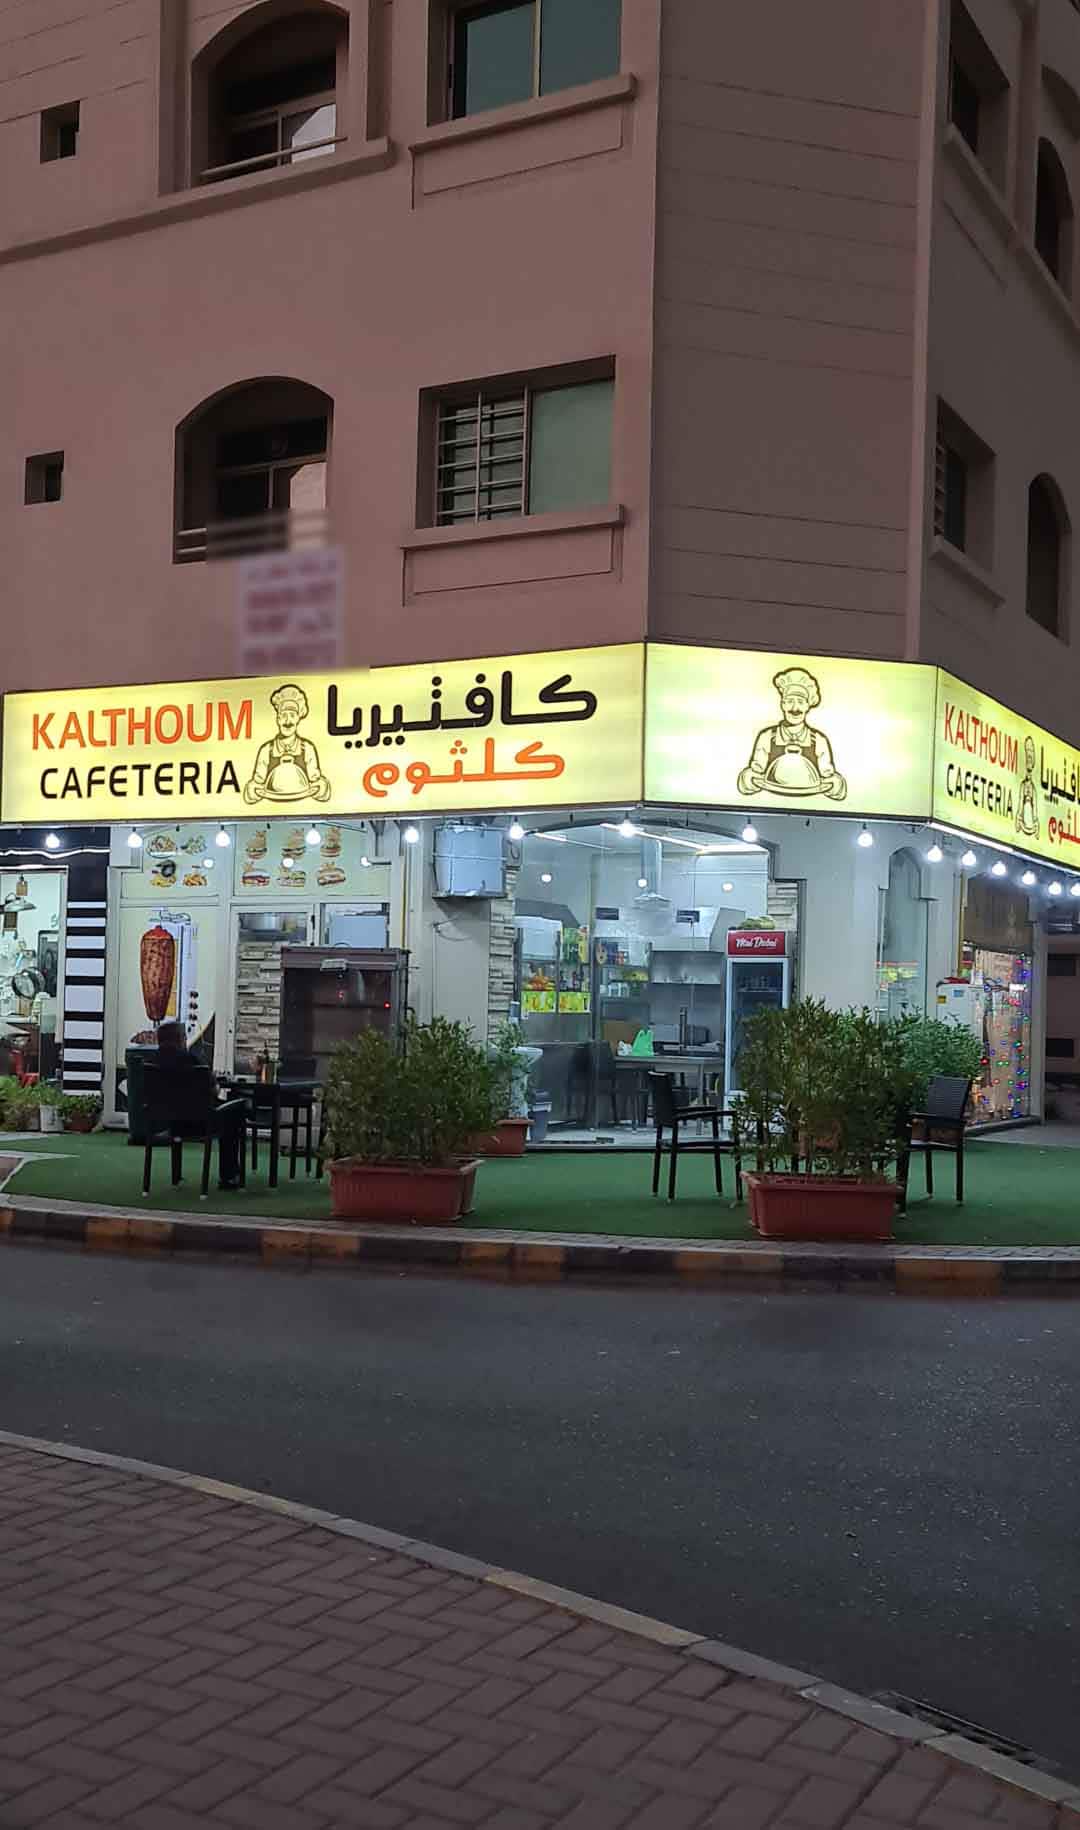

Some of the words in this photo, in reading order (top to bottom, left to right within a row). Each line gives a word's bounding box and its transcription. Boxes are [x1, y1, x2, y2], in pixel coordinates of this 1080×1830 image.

[32, 699, 253, 750] KALTHOUM
[327, 670, 598, 749] كافتيريا
[944, 702, 1018, 775] KALTHOUM
[40, 760, 241, 799] CAFETERIA
[362, 737, 565, 797] كلثوم
[946, 763, 1014, 820] CAFETERIA
[1040, 744, 1080, 805] افتيريا
[1048, 808, 1080, 845] لثوم
